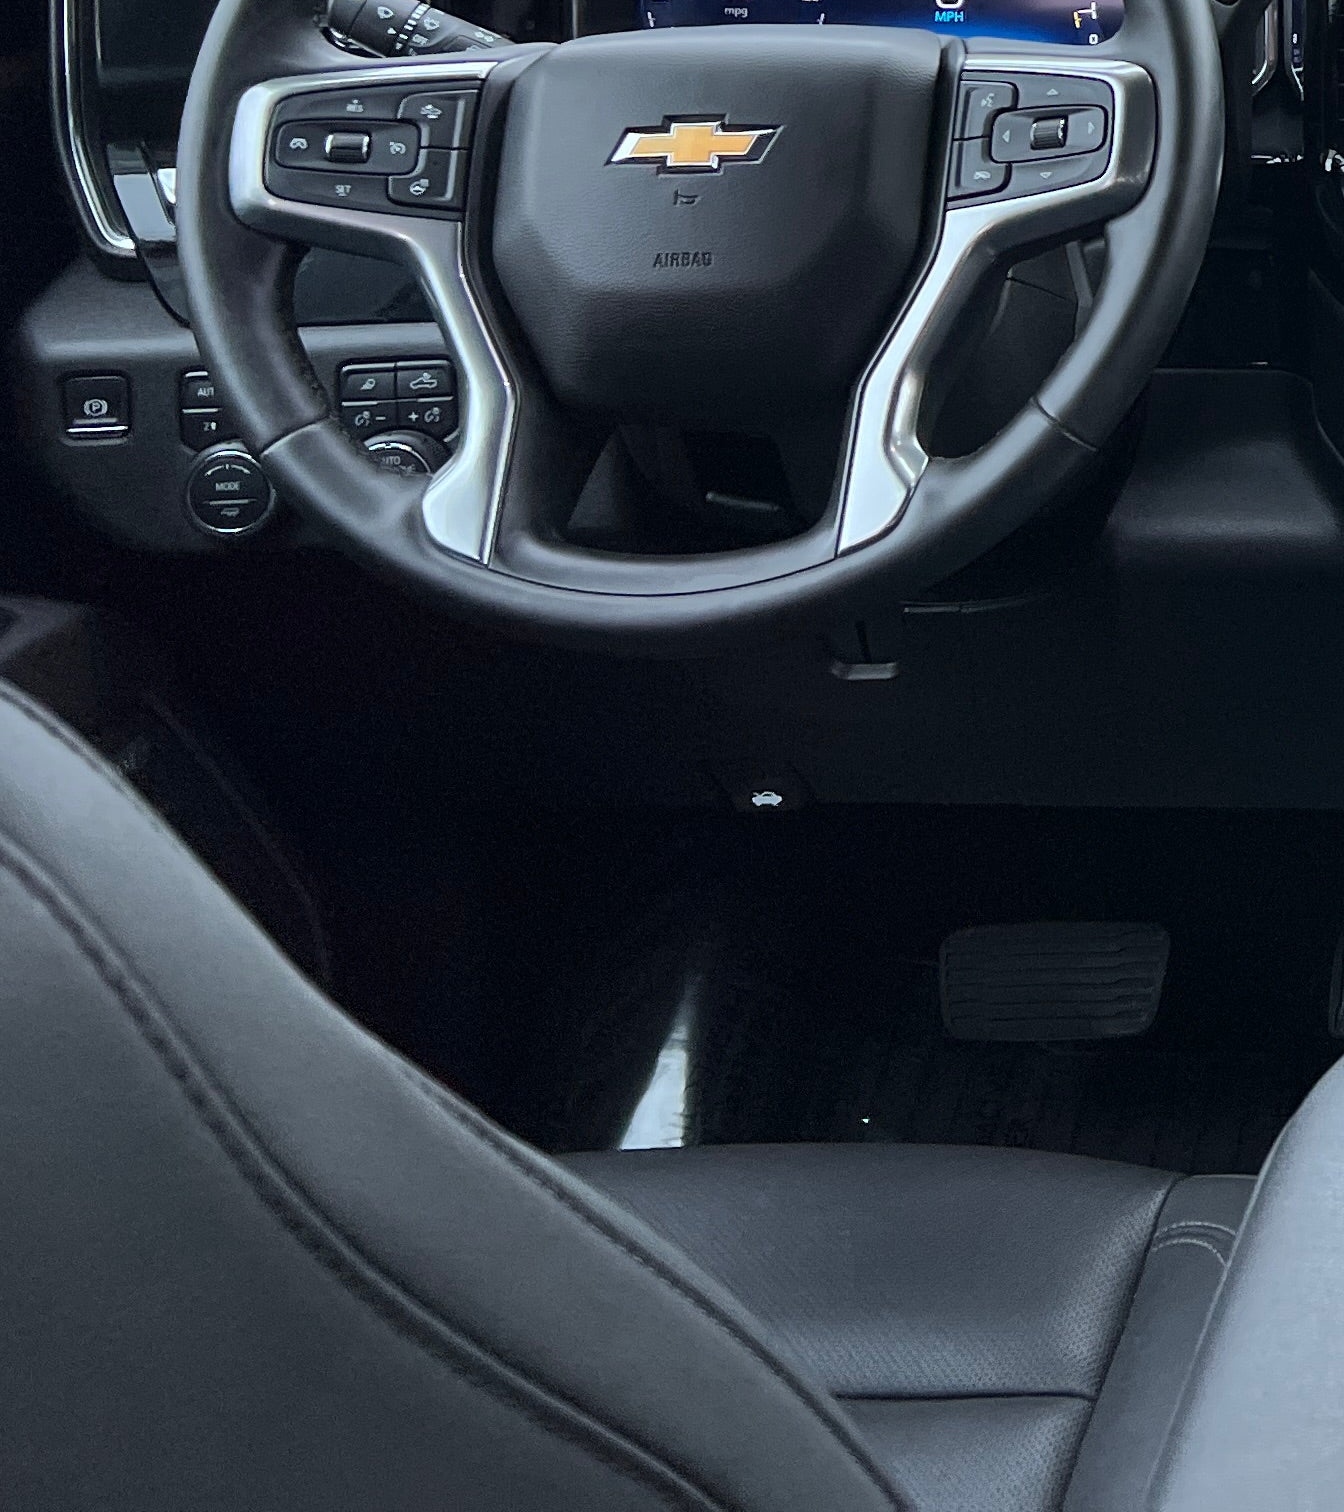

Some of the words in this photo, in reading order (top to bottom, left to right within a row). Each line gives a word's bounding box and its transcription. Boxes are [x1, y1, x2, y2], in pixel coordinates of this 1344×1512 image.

[724, 7, 748, 18] mpg
[934, 10, 964, 23] MPH
[335, 184, 352, 194] SET
[653, 251, 712, 268] AIRBAG
[215, 481, 241, 492] MODE
